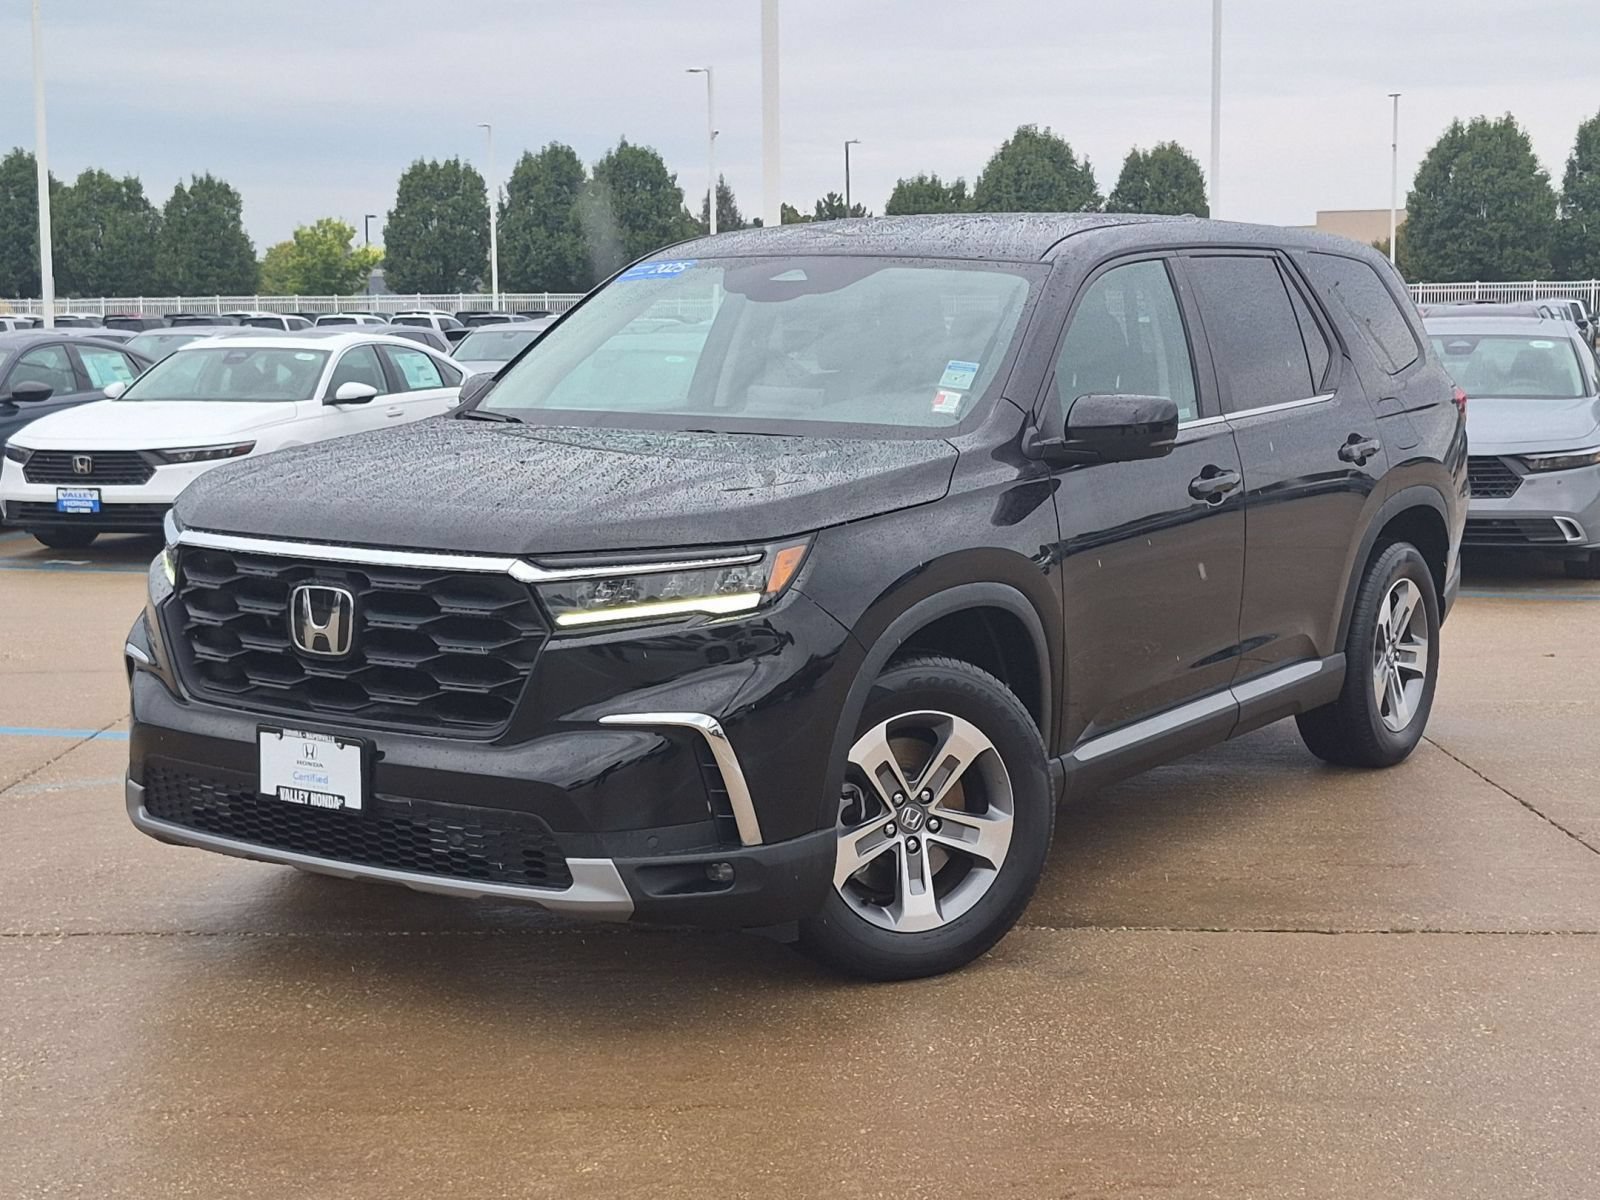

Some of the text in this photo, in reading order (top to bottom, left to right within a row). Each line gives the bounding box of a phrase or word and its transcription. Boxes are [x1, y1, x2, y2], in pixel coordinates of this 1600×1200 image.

[62, 491, 95, 499] VALLEY
[296, 759, 324, 769] HONDA
[293, 771, 328, 785] Certified
[279, 787, 309, 805] VALLEY
